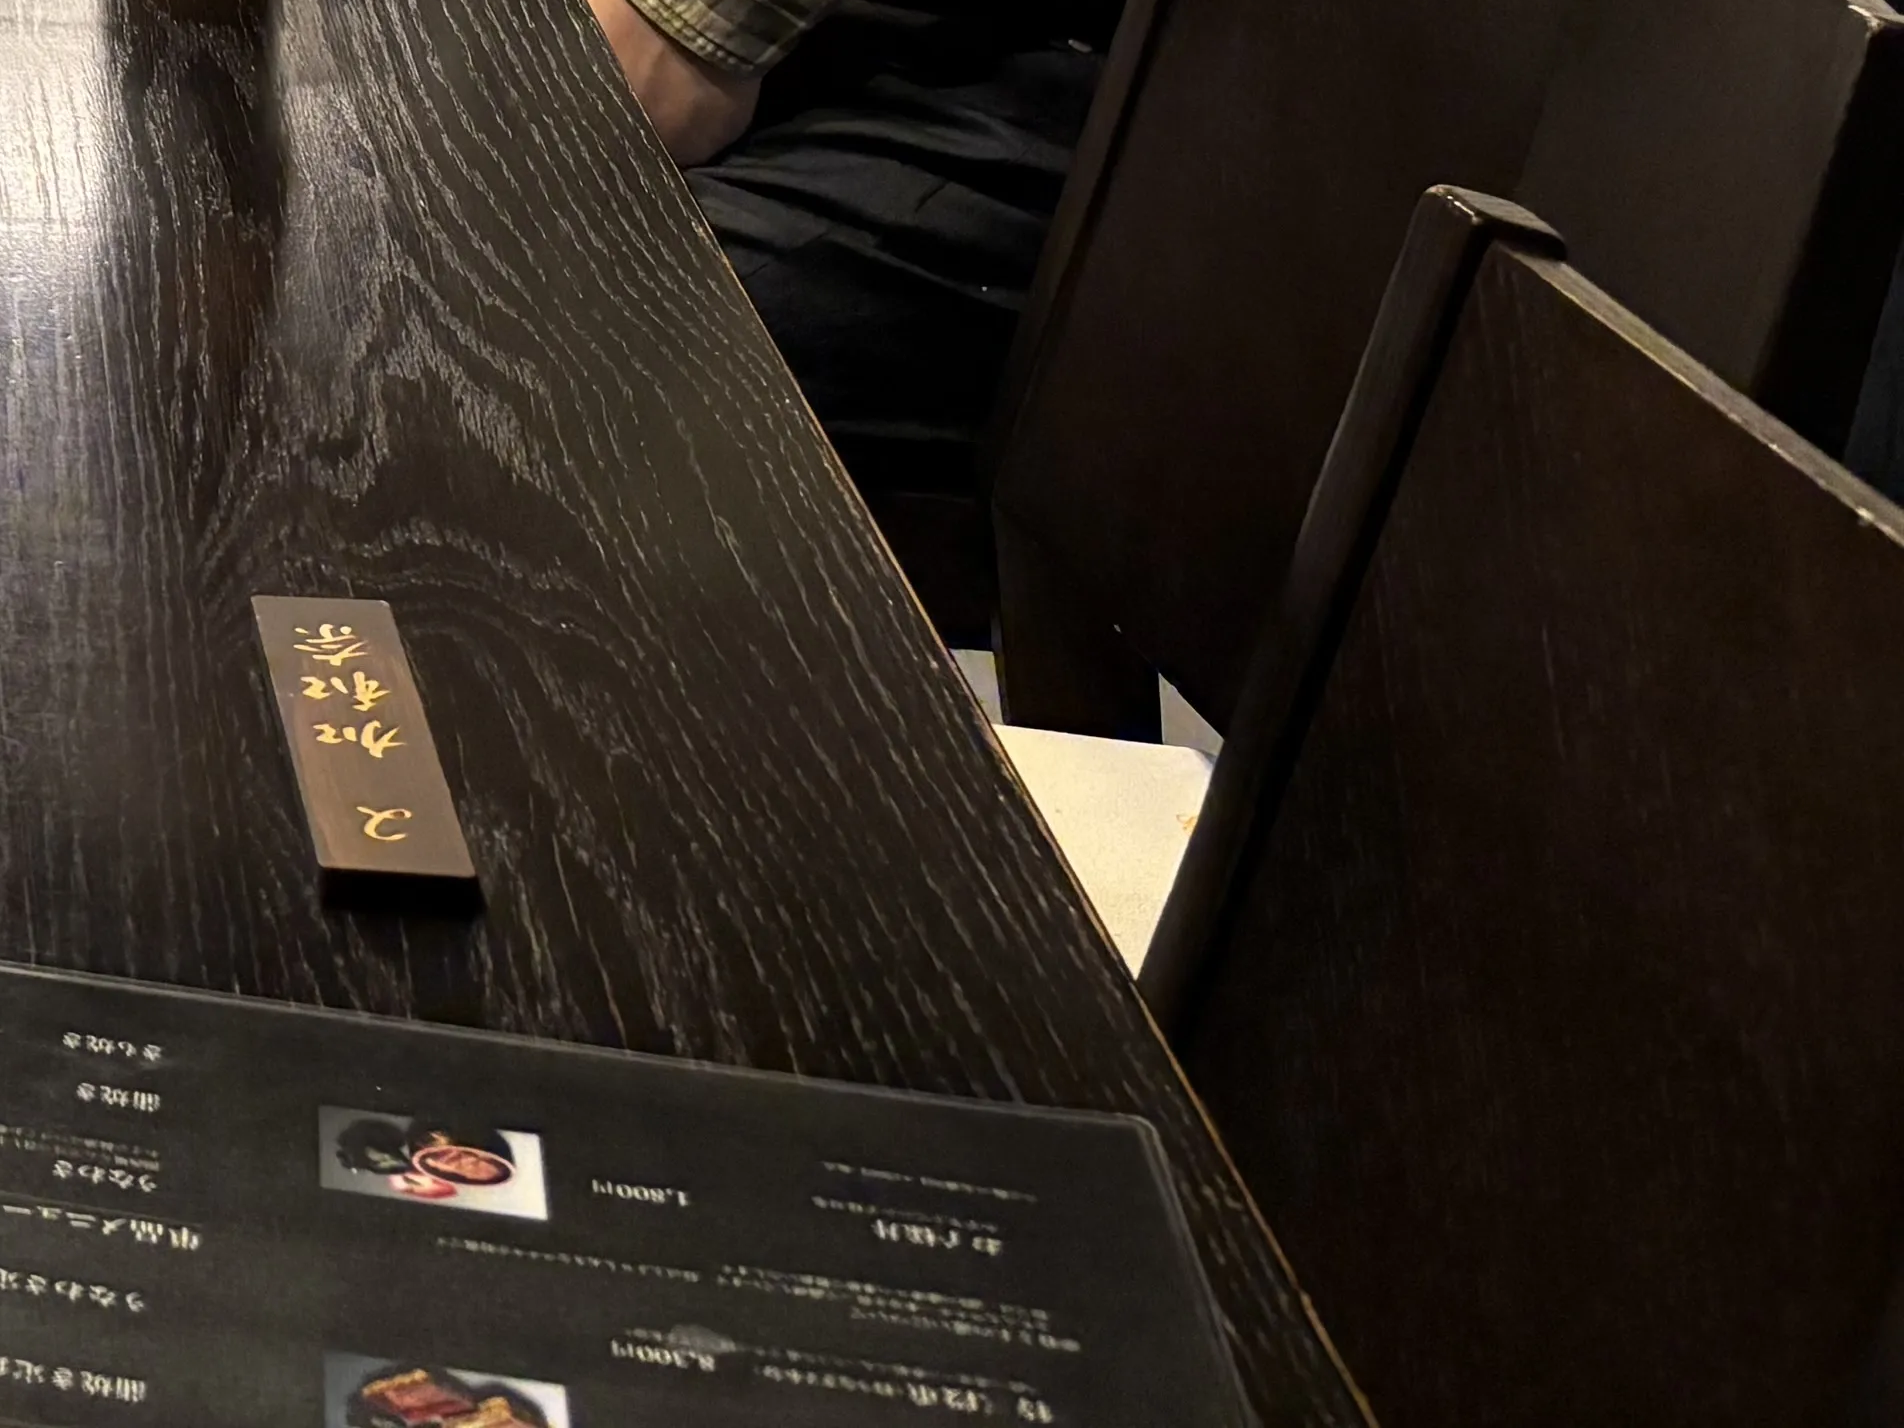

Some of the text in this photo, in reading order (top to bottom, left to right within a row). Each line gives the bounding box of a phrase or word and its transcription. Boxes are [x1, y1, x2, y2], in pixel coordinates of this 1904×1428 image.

[62, 1031, 163, 1062] きも焼き
[76, 1082, 161, 1113] 蒲焼き
[591, 1178, 690, 1207] 1,800円
[2, 1205, 201, 1251] 単品メニュー
